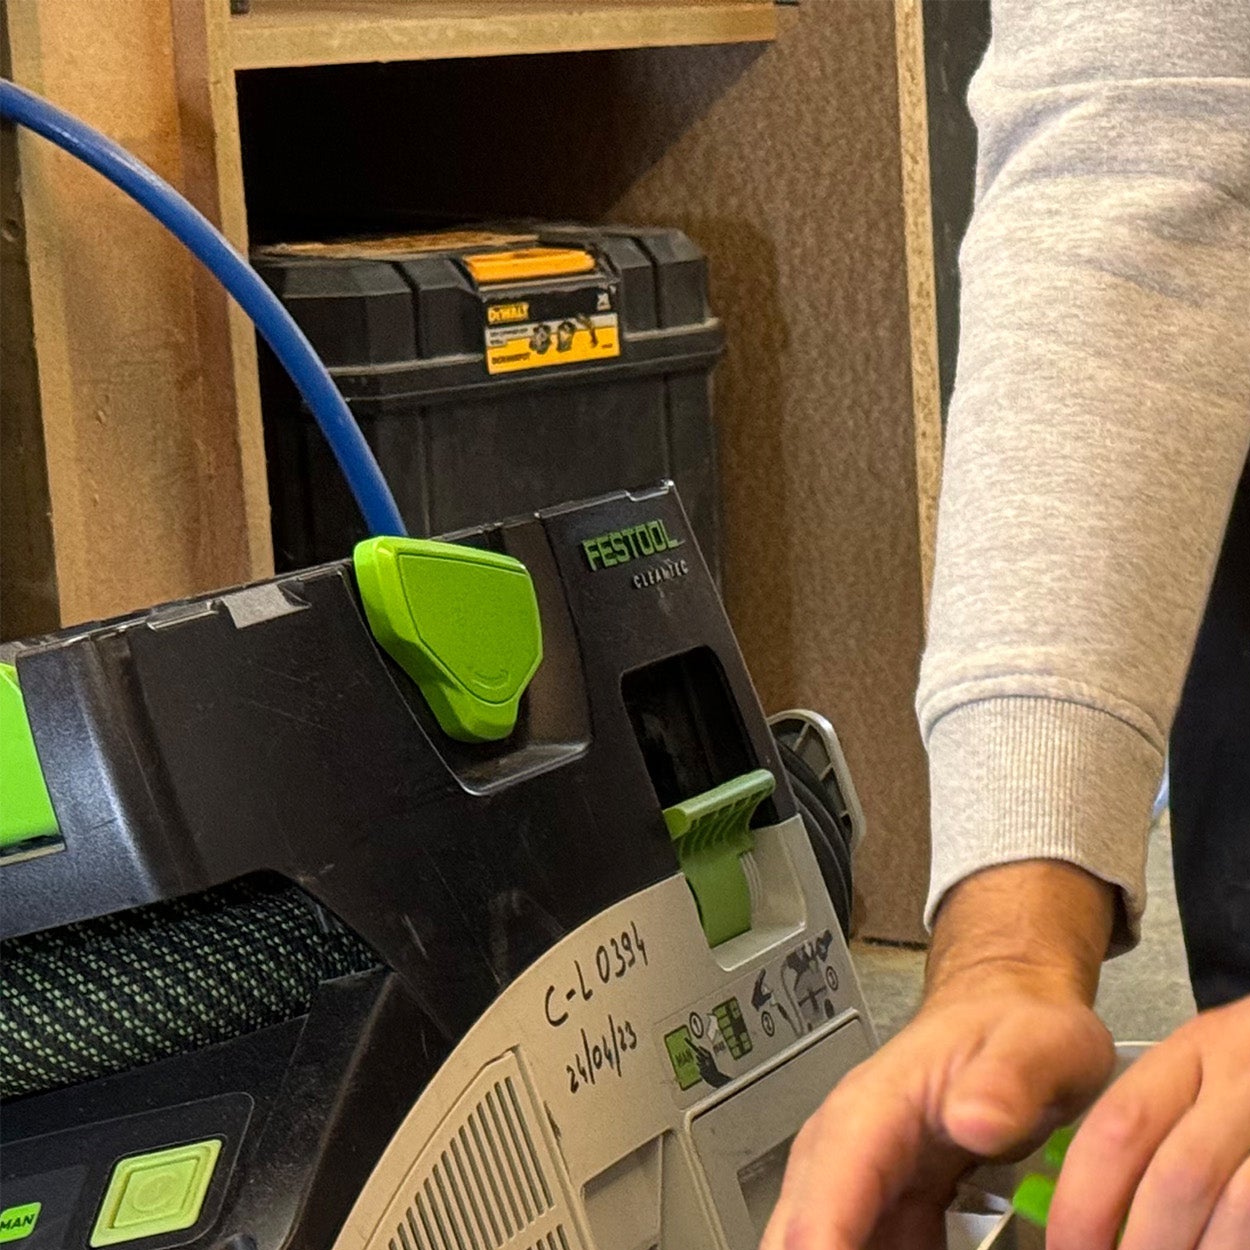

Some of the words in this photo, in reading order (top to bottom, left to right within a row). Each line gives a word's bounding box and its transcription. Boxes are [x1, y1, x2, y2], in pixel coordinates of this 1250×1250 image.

[581, 519, 681, 571] FESTOOL
[545, 960, 593, 1027] C-L
[566, 1014, 637, 1093] 24/04/23
[0, 1214, 35, 1230] MAN
